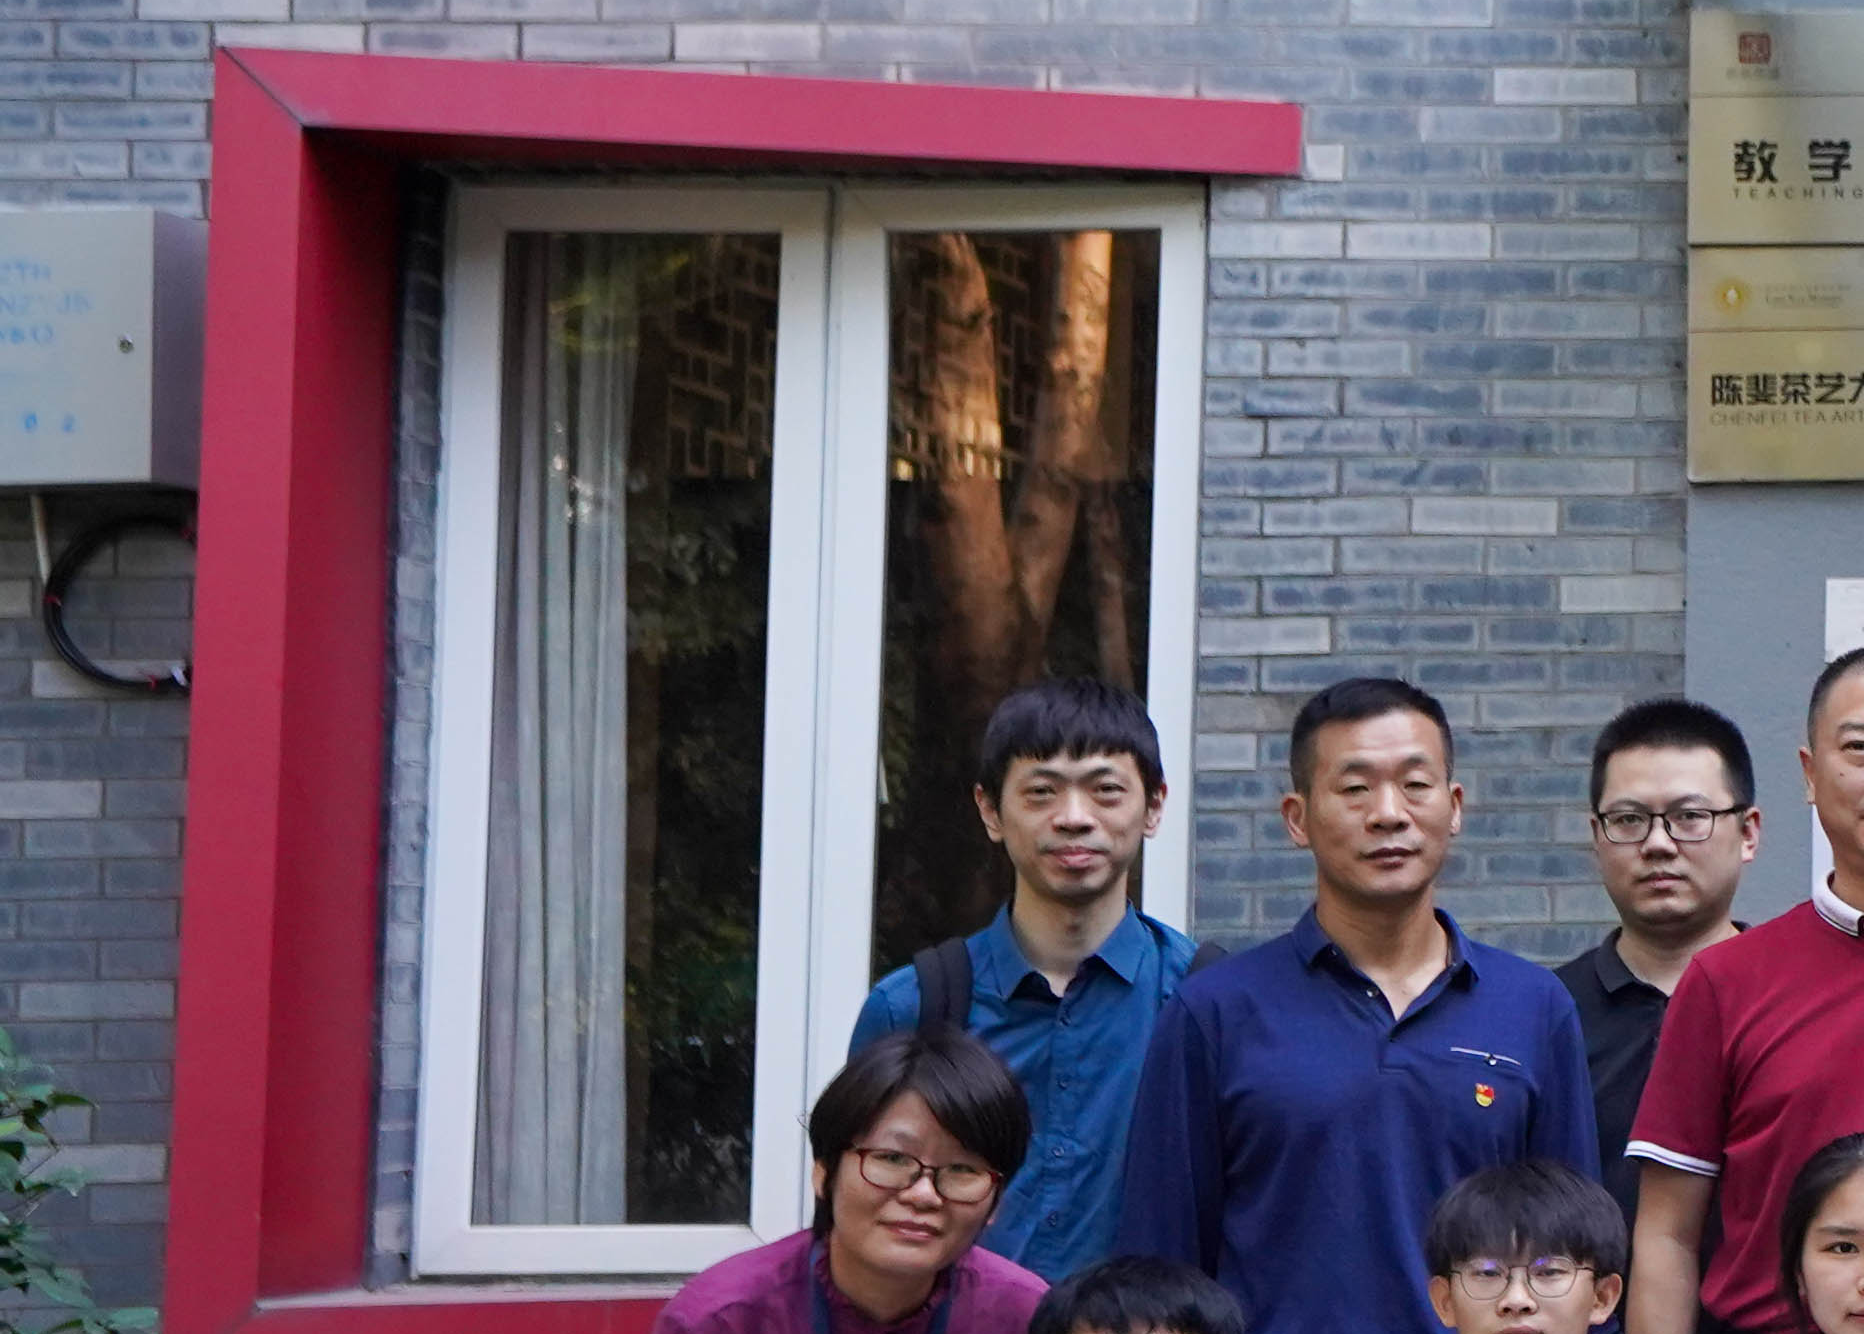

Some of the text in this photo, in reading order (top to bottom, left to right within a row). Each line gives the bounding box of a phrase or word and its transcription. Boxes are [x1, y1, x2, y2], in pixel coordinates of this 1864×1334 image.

[1733, 186, 1864, 200] TEACHING
[1794, 410, 1827, 424] TEA
[1832, 409, 1864, 423] ART
